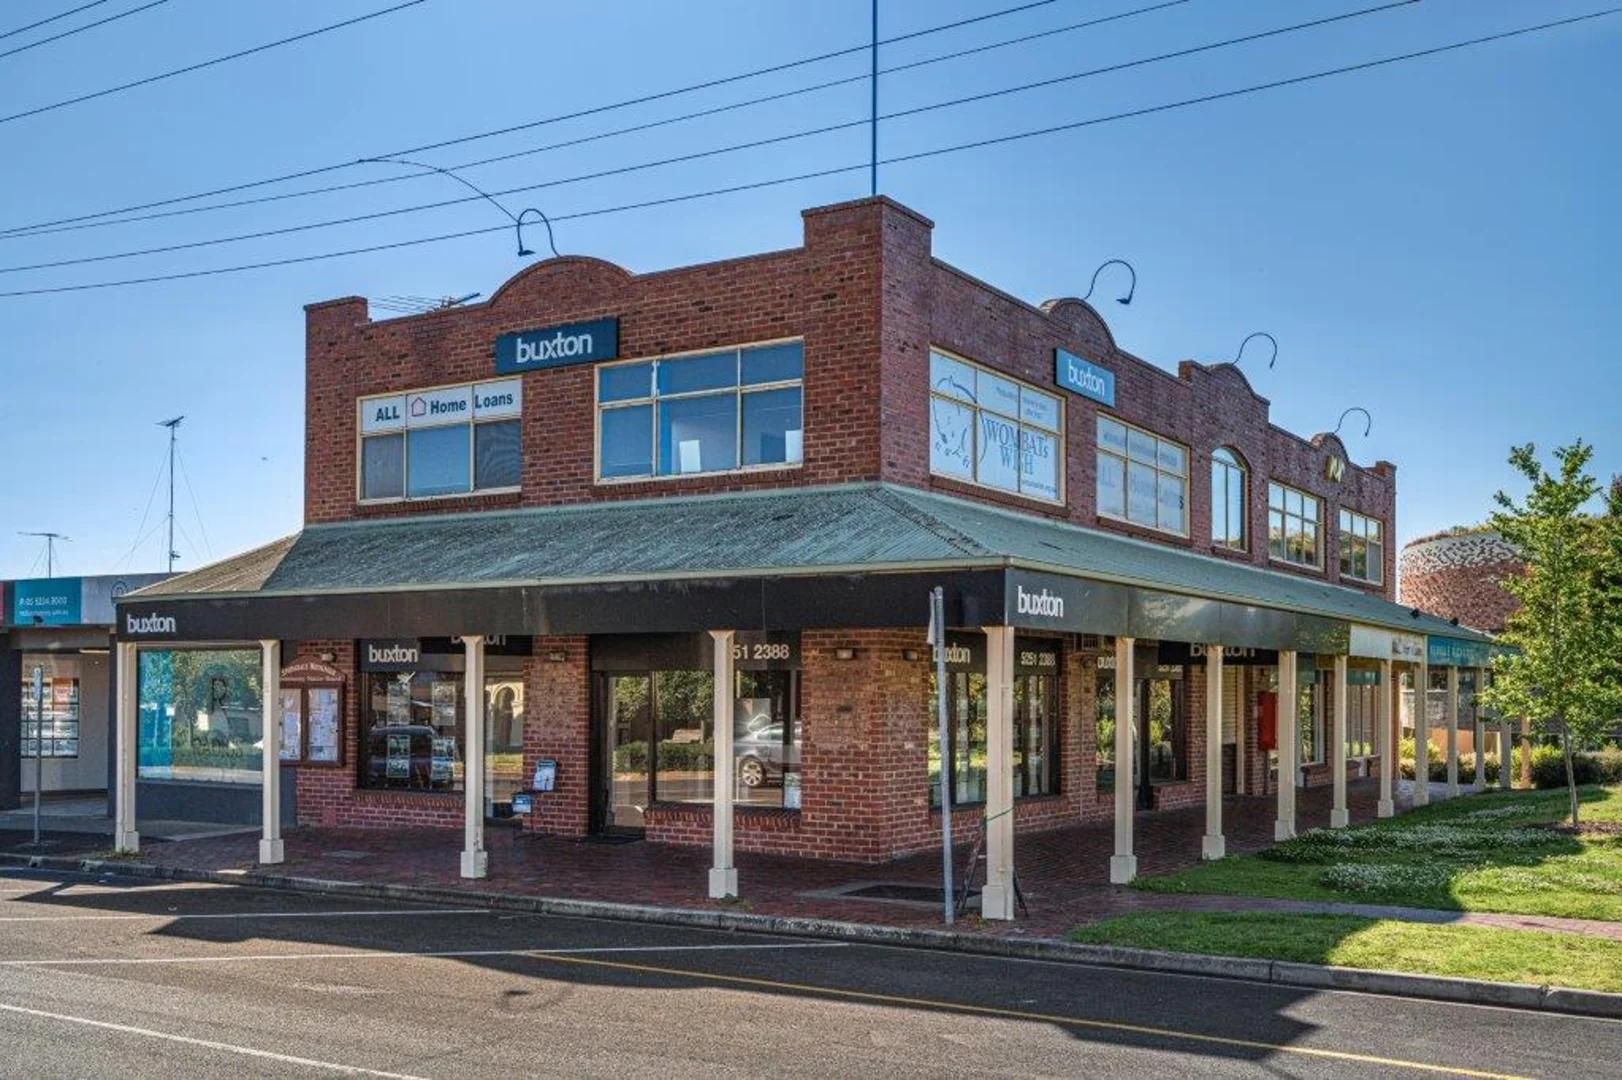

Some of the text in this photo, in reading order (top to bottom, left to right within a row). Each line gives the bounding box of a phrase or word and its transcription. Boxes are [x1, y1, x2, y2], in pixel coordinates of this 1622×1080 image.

[515, 331, 592, 364] buxton
[1067, 358, 1106, 396] buxton
[375, 392, 513, 422] ALL Home Loans
[1017, 585, 1064, 618] buxton
[126, 613, 177, 634] buxton
[368, 644, 418, 663] buxton
[753, 643, 790, 660] 2388
[932, 642, 971, 664] bxton
